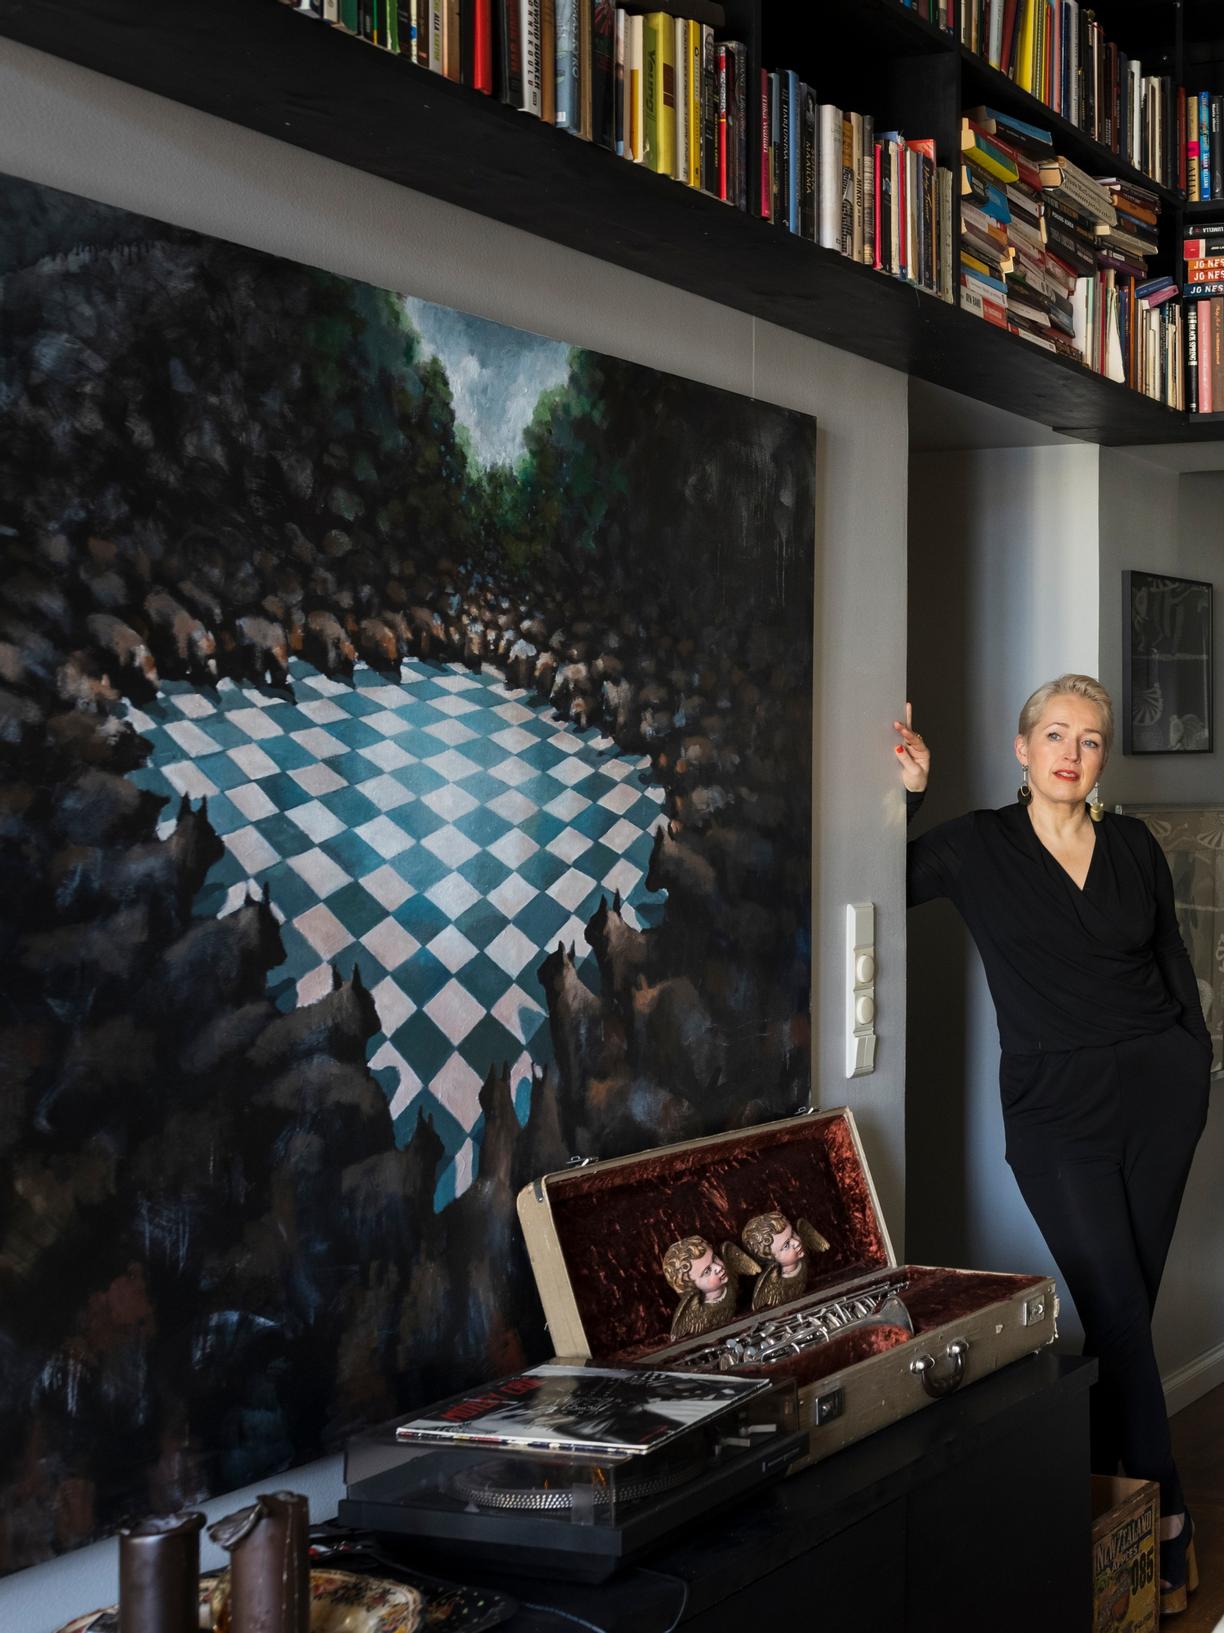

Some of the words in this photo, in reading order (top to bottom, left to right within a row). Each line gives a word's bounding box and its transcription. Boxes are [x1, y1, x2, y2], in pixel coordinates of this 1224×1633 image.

[1194, 261, 1205, 270] JO
[1193, 272, 1205, 281] JO
[1190, 286, 1202, 294] JO
